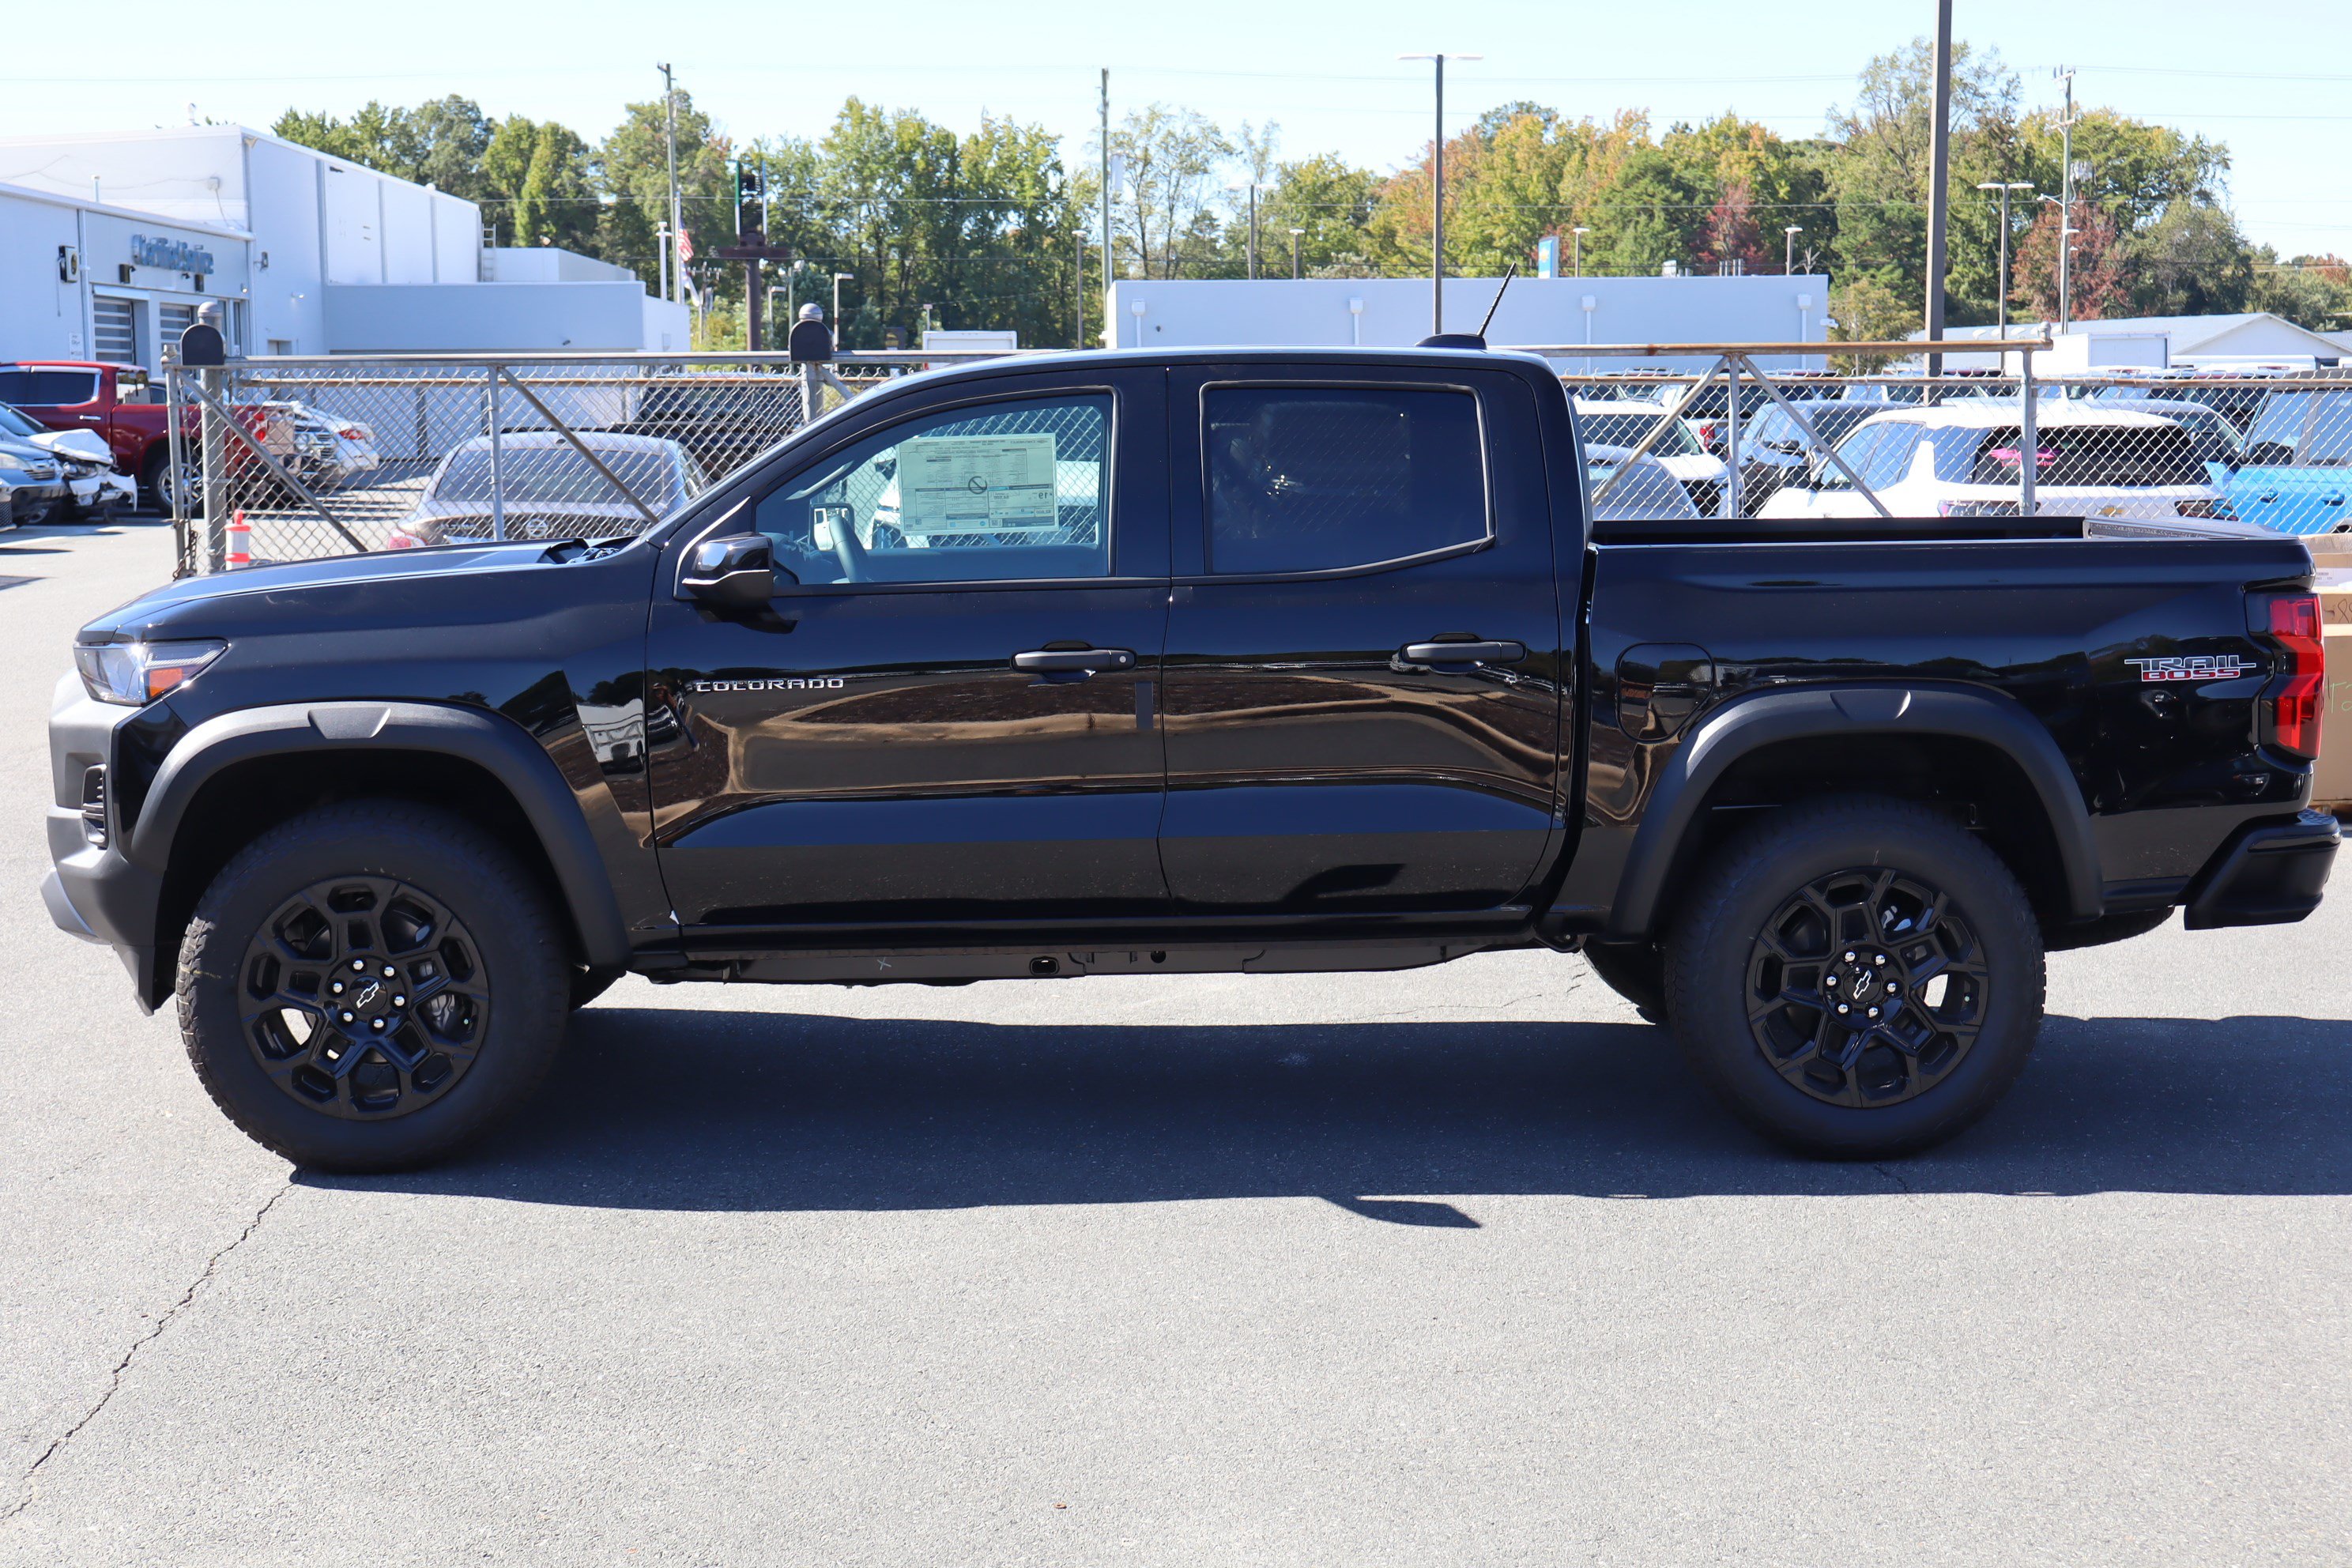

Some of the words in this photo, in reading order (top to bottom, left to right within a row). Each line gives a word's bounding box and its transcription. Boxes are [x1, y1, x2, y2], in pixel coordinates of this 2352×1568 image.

[2124, 655, 2256, 671] TRAIL
[2142, 668, 2241, 682] BOSS
[696, 678, 844, 692] COLORADO
